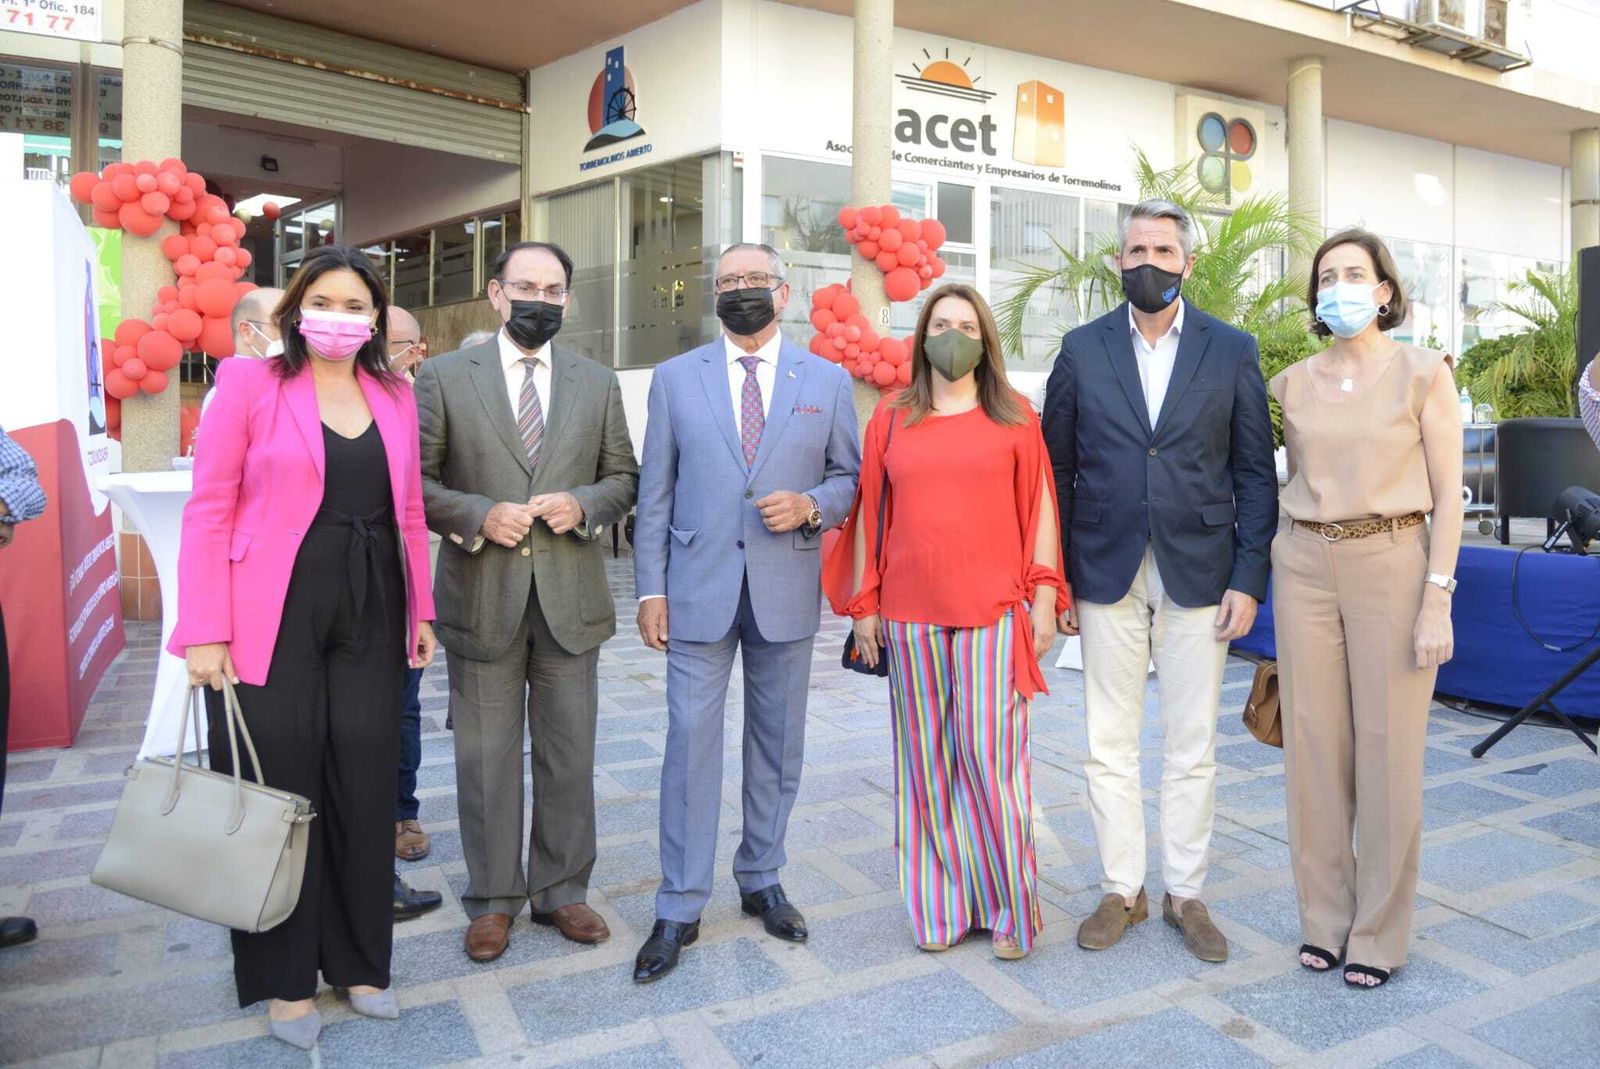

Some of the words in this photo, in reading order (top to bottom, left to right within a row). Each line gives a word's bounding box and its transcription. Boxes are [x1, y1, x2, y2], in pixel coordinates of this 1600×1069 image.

[40, 0, 68, 12] Ofic.
[73, 5, 95, 15] 184
[7, 9, 33, 26] 71
[46, 15, 74, 31] 77
[895, 108, 997, 156] acet
[579, 152, 625, 171] TORREMOLINOS
[626, 144, 653, 158] ABIERTO
[905, 152, 975, 171] Comerciantes
[977, 164, 983, 174] y
[985, 164, 1046, 181] Empresarios
[1048, 173, 1060, 184] de
[1062, 175, 1122, 192] Torremolinos
[881, 308, 890, 325] 8
